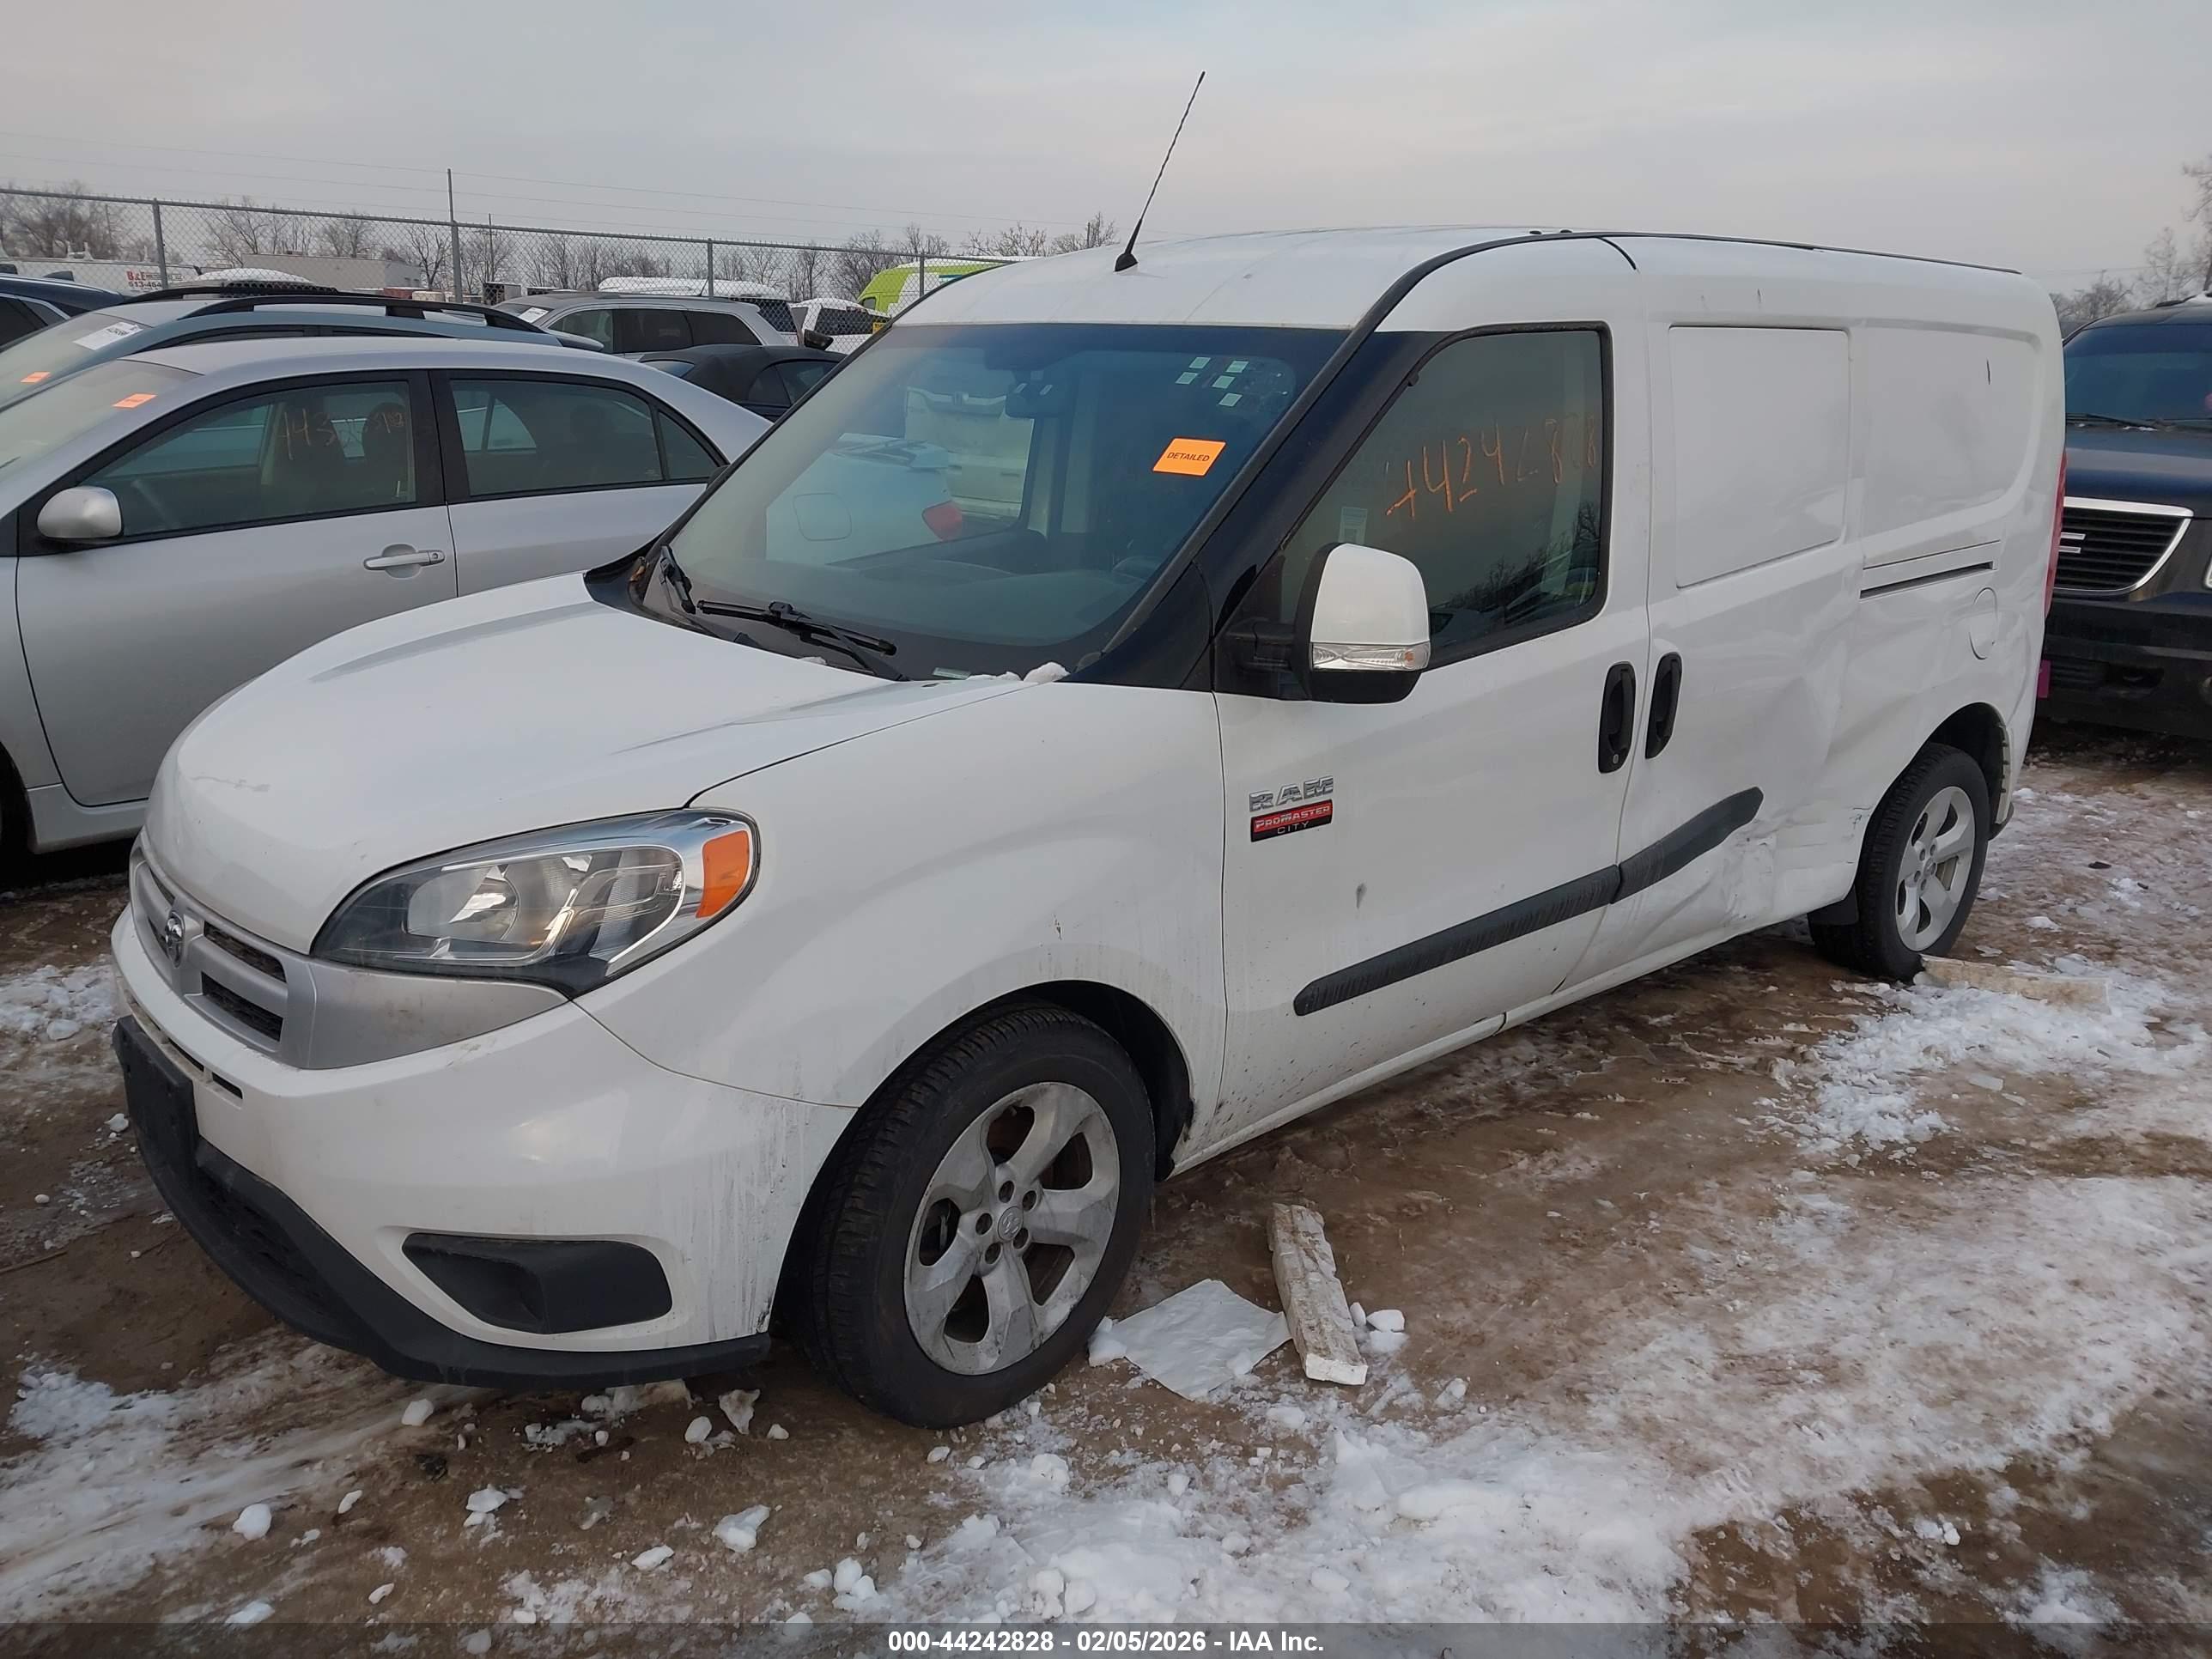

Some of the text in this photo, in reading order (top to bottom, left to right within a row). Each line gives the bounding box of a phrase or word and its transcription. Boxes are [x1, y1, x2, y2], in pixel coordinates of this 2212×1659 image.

[1166, 452, 1210, 462] DETAILED
[1249, 775, 1334, 811] RAM
[1277, 821, 1310, 835] CITY
